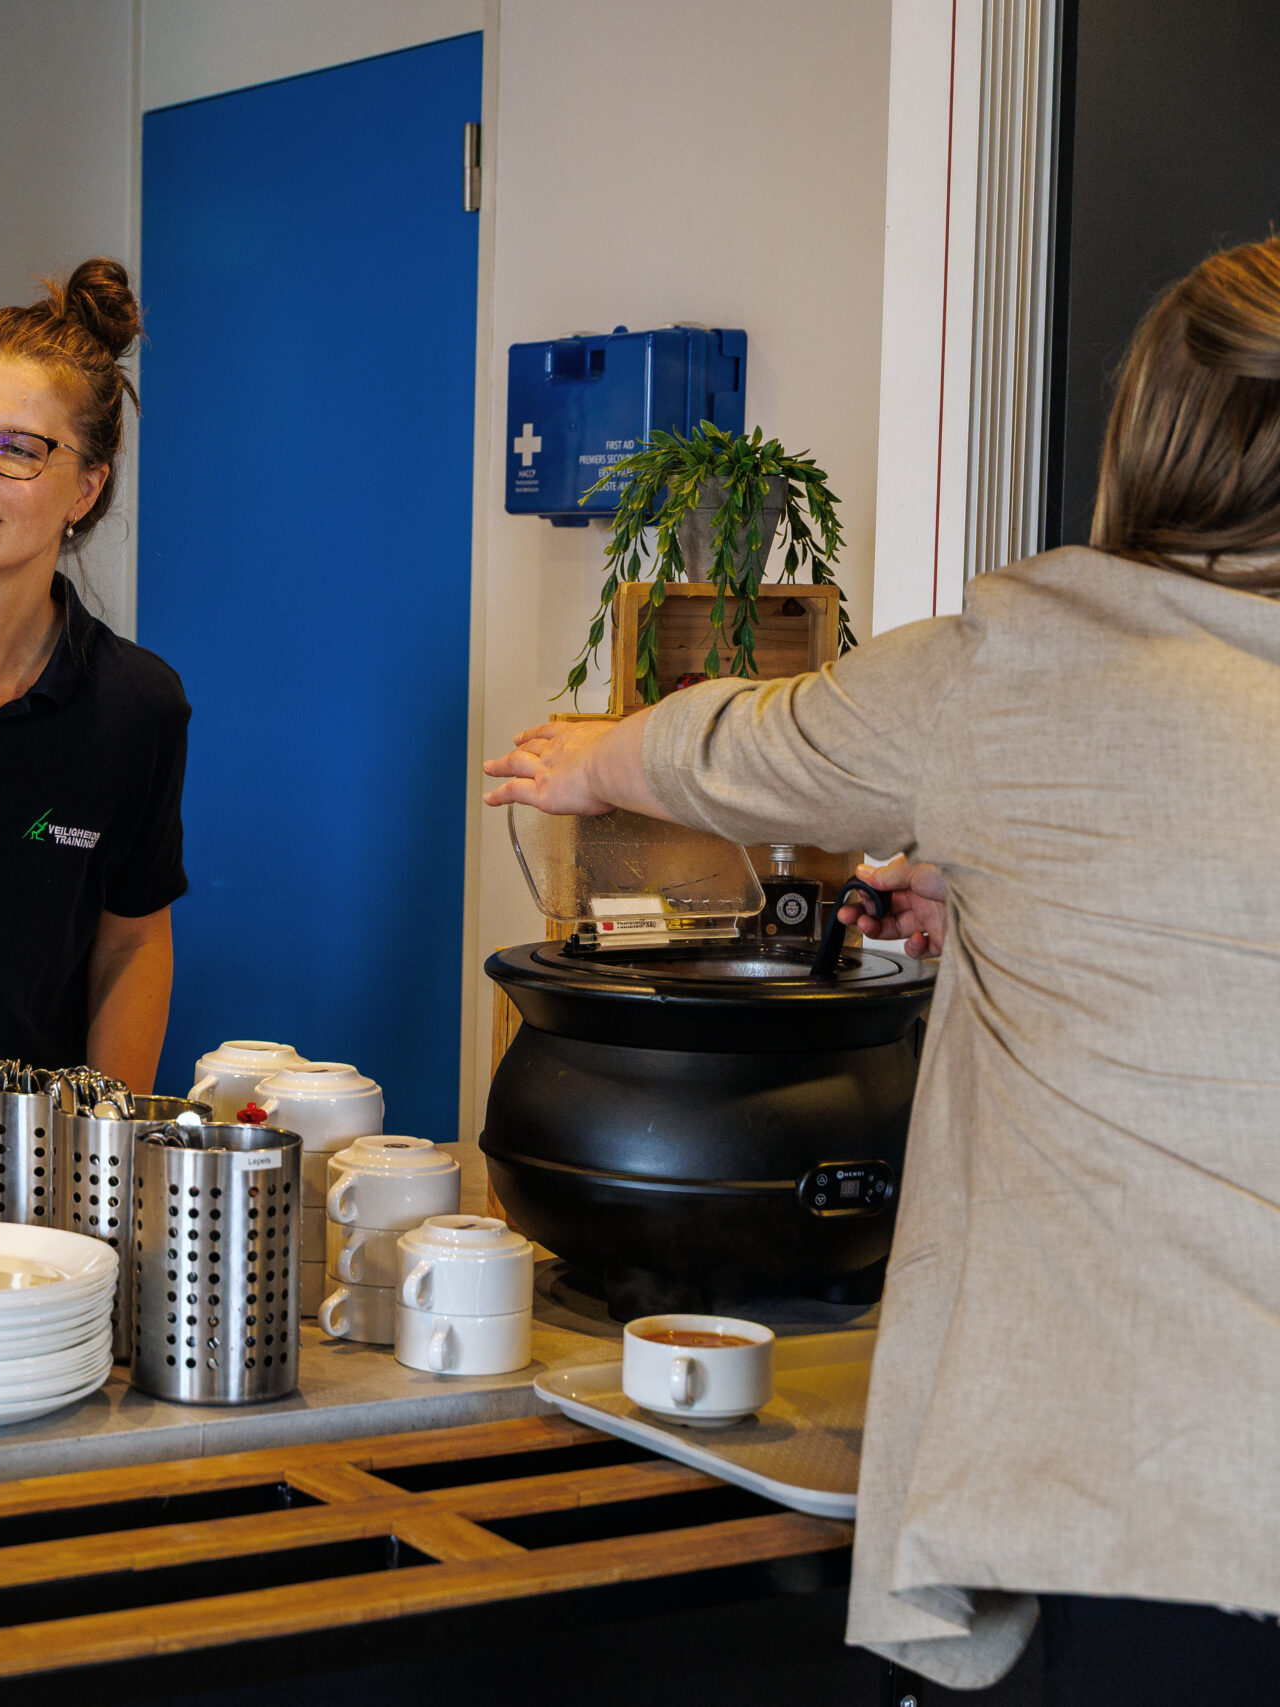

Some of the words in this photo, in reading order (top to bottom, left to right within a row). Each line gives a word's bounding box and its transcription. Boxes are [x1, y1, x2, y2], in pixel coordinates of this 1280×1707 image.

[606, 440, 622, 450] FIRST
[623, 439, 635, 450] AID
[579, 454, 606, 465] PREMIERS
[247, 1157, 272, 1166] Lepels
